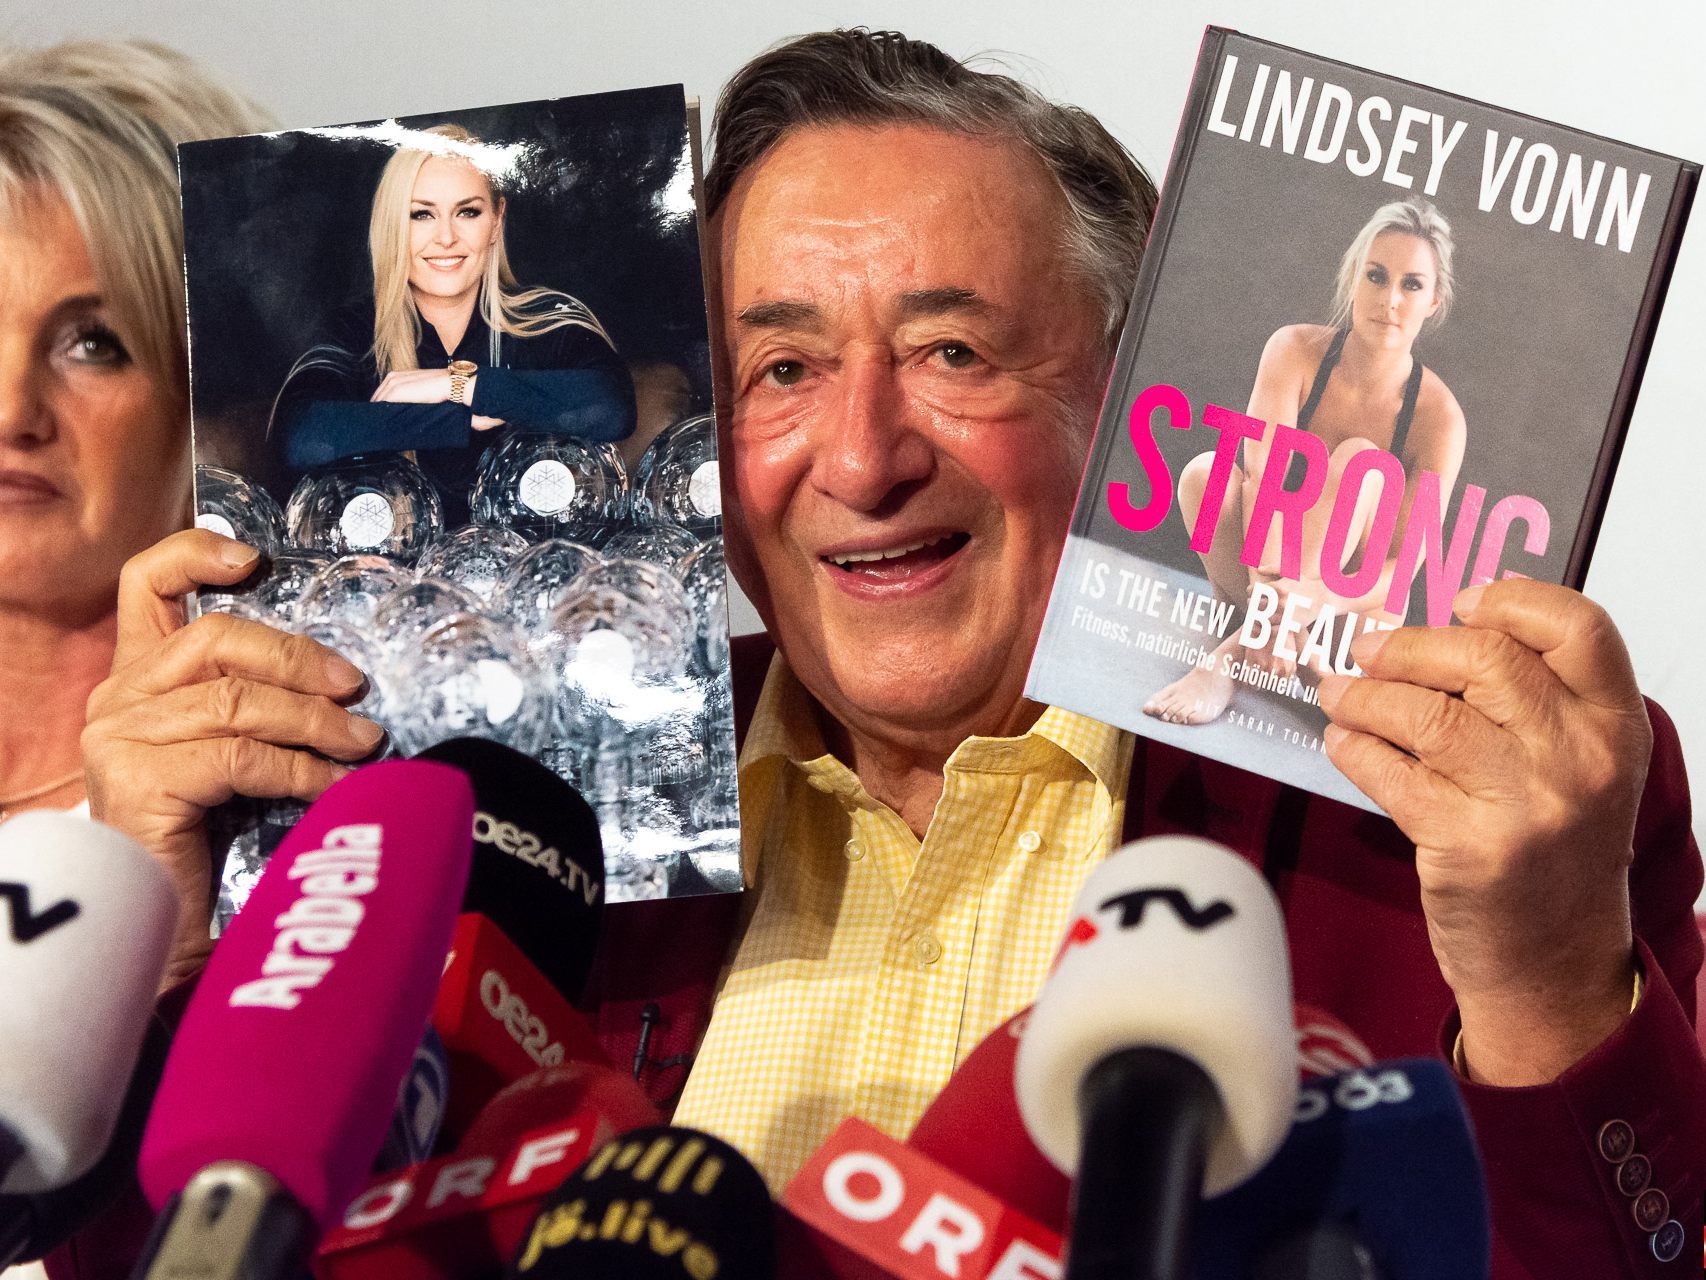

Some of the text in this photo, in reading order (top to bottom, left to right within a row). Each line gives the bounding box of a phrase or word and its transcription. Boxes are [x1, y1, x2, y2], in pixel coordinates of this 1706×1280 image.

[1207, 54, 1652, 254] LINDSEY VONN
[1107, 384, 1552, 628] STRONG
[1071, 605, 1132, 649] Fitness,
[1135, 630, 1217, 672] natürliche
[1220, 653, 1301, 700] Schönheit
[1079, 558, 1398, 679] IS THE NEW BEAU
[1227, 710, 1275, 737] SARAH
[228, 823, 384, 1011] Arabella
[342, 1128, 580, 1231] ORF
